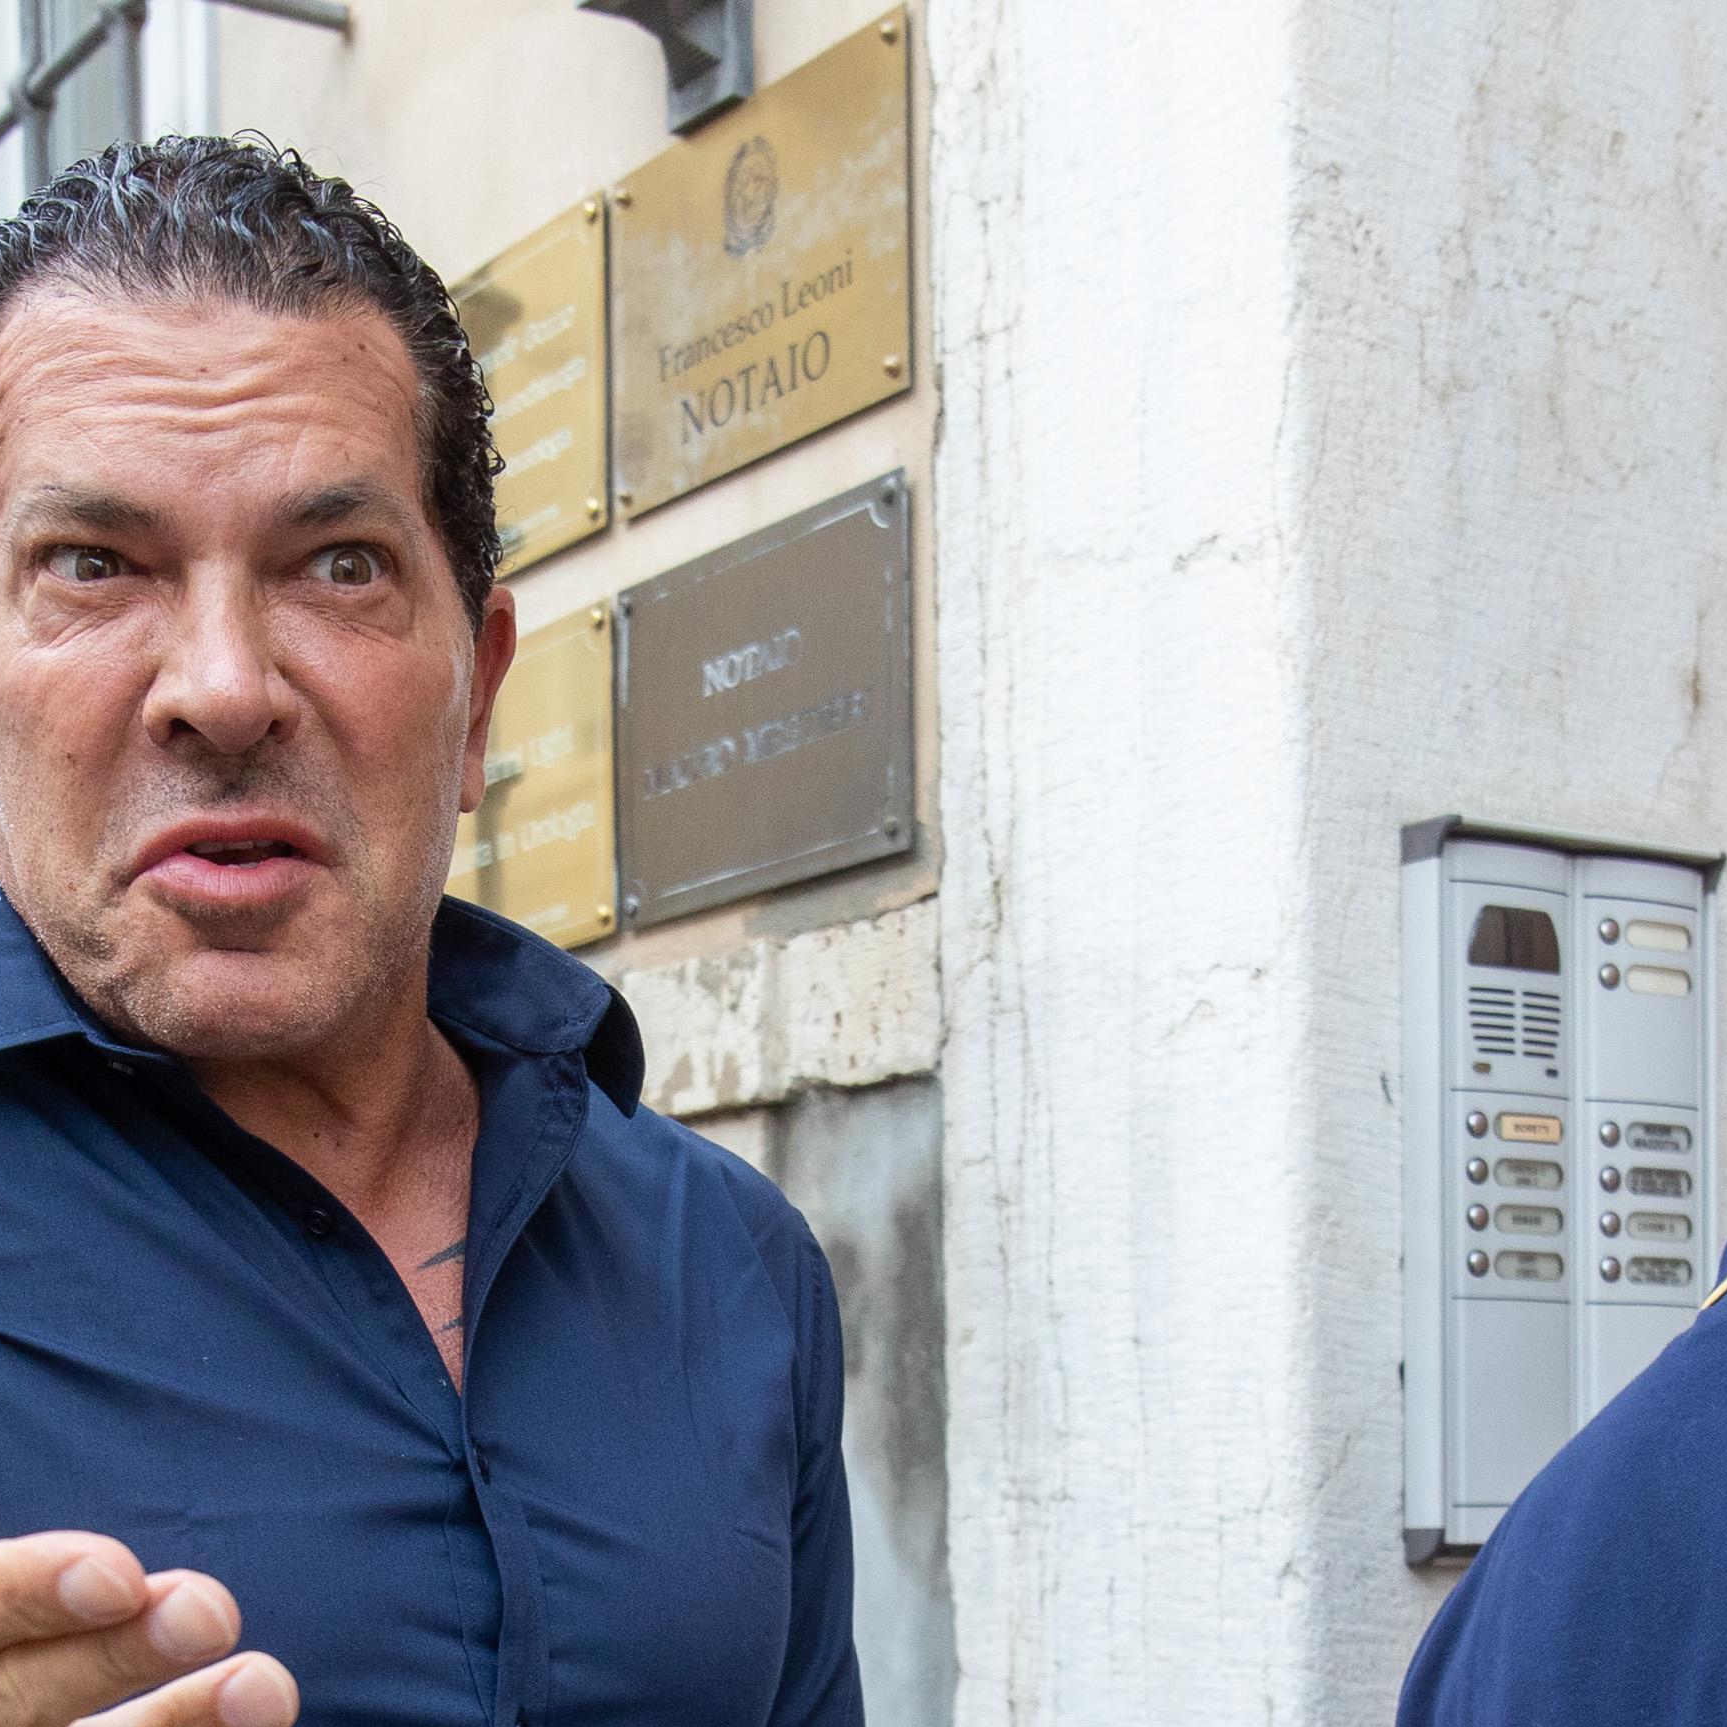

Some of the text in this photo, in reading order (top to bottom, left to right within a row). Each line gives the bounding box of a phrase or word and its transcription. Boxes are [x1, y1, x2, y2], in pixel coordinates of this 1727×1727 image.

[657, 302, 774, 383] Francesco
[780, 247, 854, 319] Leoni
[681, 330, 831, 446] NOTAIO
